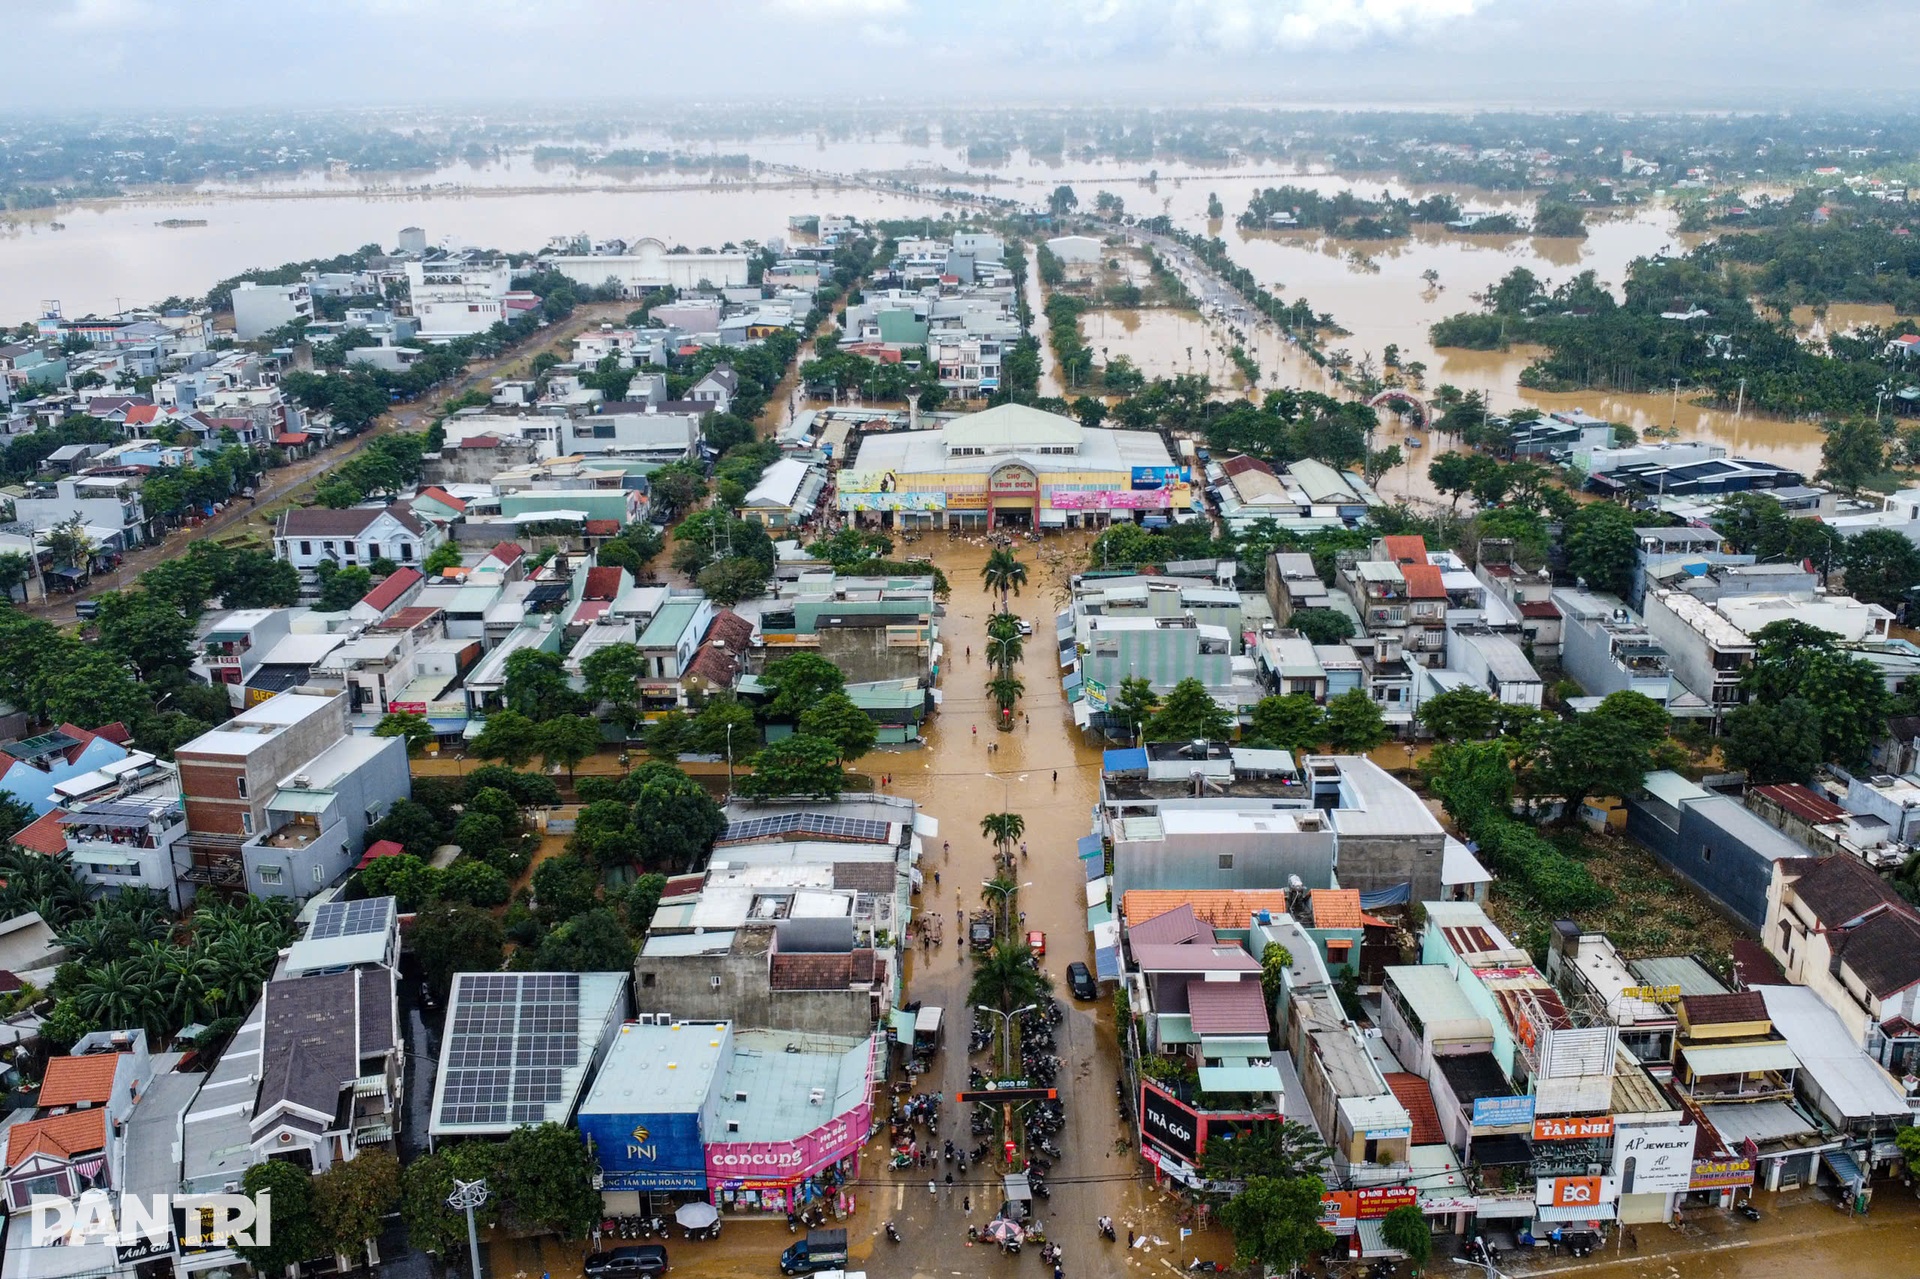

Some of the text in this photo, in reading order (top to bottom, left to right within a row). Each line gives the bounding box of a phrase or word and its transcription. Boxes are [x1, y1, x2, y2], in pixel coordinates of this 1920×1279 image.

[1147, 1108, 1191, 1141] TRẢ GÓP
[1542, 1123, 1610, 1136] TÂM NHI
[626, 1144, 657, 1162] PNJ
[1643, 1141, 1689, 1150] JEWELRY
[683, 1179, 697, 1187] PNJ
[1562, 1185, 1591, 1203] BQ
